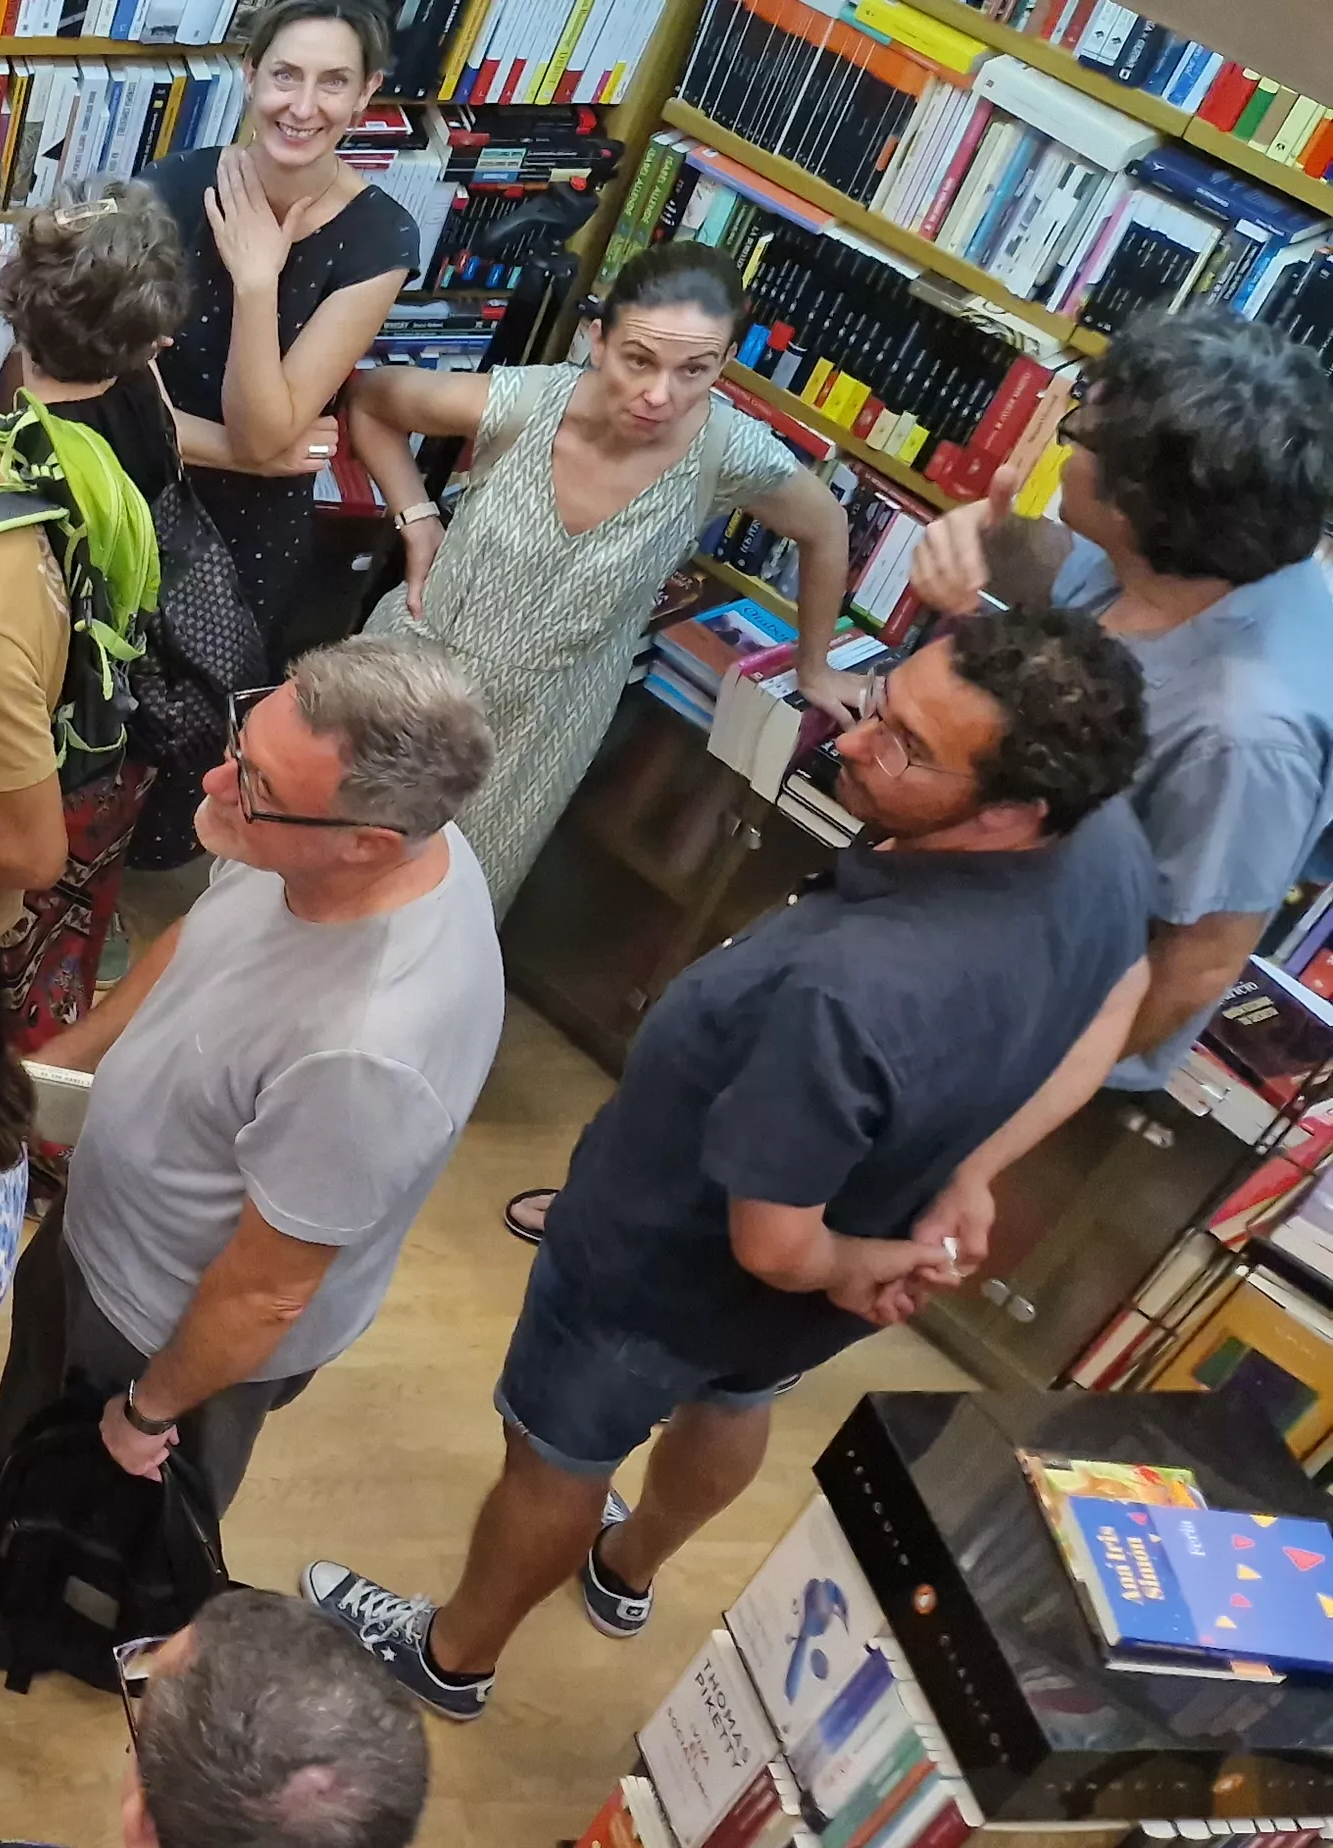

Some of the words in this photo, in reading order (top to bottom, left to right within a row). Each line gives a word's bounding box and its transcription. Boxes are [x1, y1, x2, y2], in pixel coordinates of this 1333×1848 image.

[638, 147, 656, 178] ISABEL
[657, 155, 675, 185] ISABEL
[624, 178, 645, 217] ALLENDE
[640, 187, 662, 225] ALLENDE
[694, 1671, 748, 1769] PIKETTY
[698, 1657, 751, 1763] THOMAS
